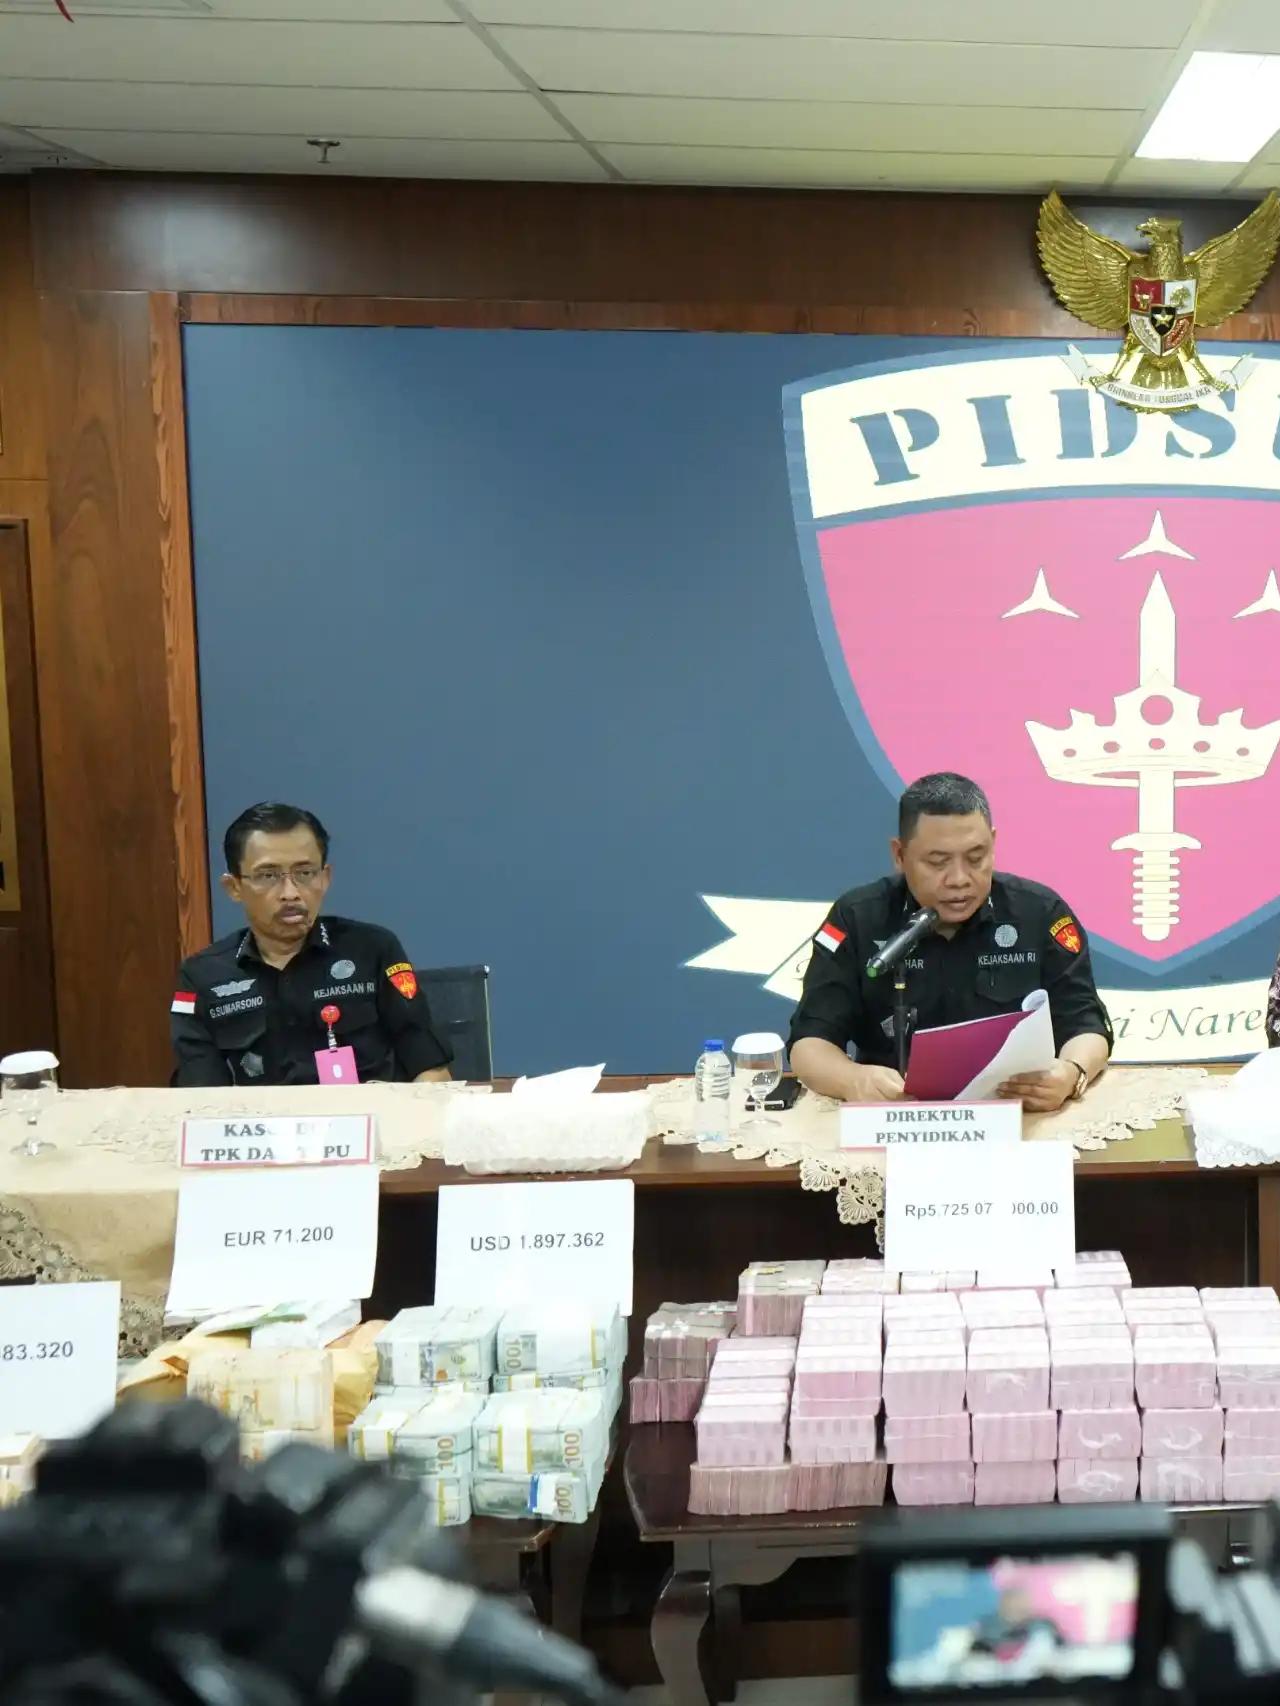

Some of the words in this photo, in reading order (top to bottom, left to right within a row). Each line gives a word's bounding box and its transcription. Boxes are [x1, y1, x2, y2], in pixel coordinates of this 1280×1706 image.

[978, 953, 1024, 966] KEJAKSAAN
[1027, 952, 1036, 963] RI
[313, 983, 364, 999] KEJAKSAAN
[366, 982, 375, 993] RI
[886, 1109, 975, 1123] DIREKTUR
[875, 1130, 986, 1144] PENYIDIKAN
[200, 1148, 241, 1162] TPK
[224, 1231, 267, 1248] EUR
[273, 1226, 334, 1245] 71.200
[470, 1236, 511, 1251] USD
[520, 1232, 605, 1249] 1.897.362
[0, 1340, 74, 1360] 83.320
[564, 1432, 580, 1465] 100
